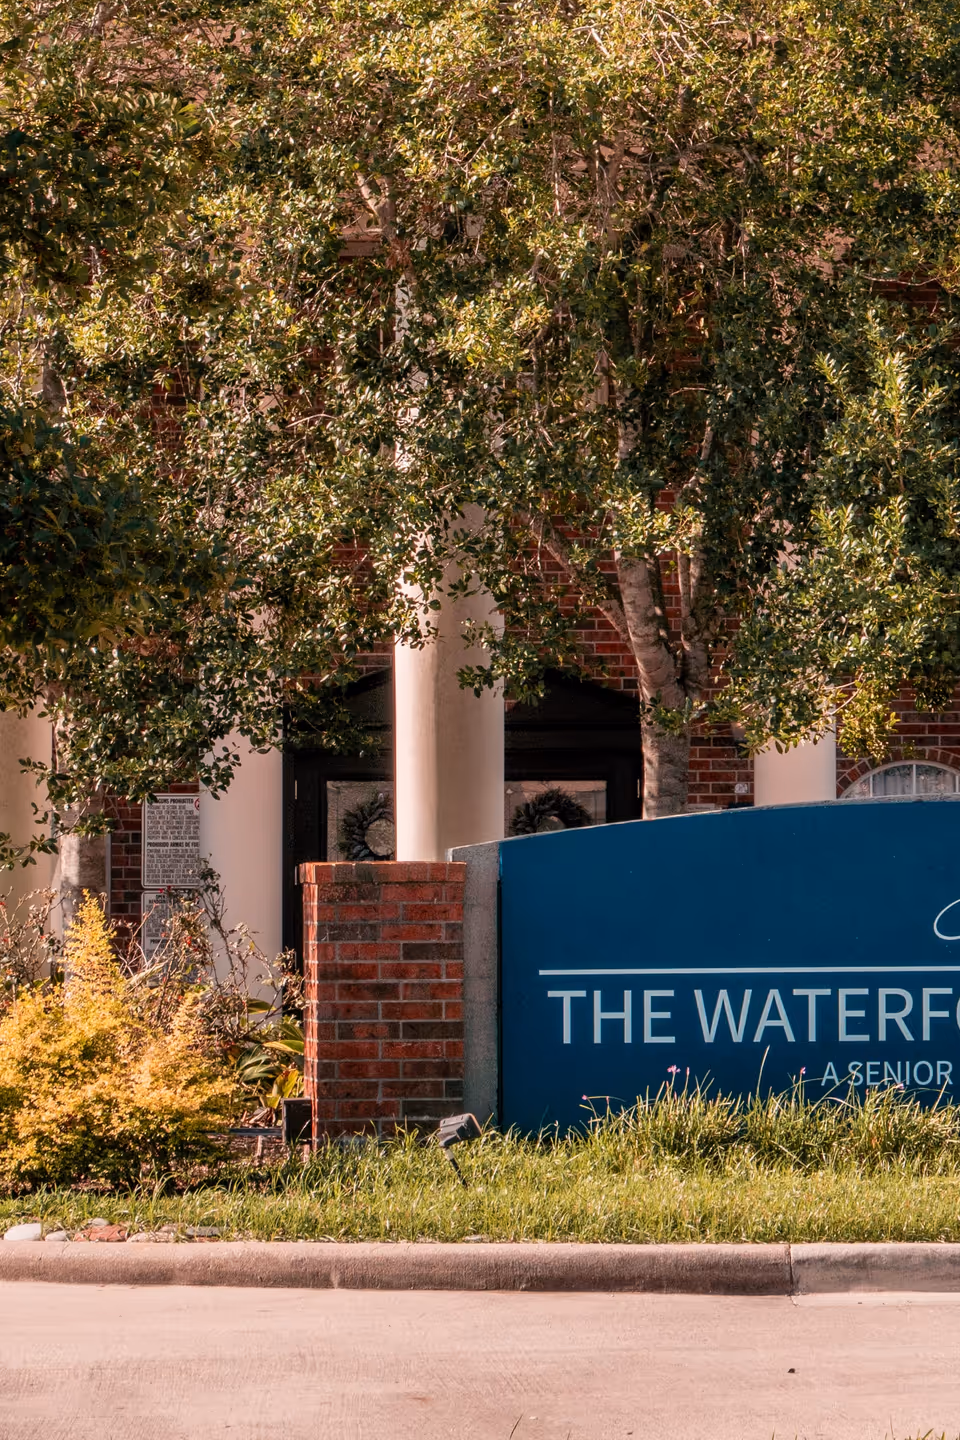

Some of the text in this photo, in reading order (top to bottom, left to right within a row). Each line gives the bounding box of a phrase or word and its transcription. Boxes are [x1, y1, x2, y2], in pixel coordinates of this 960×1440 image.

[547, 989, 676, 1044] THE
[820, 1061, 840, 1086] A
[847, 1060, 953, 1086] SENIOR
